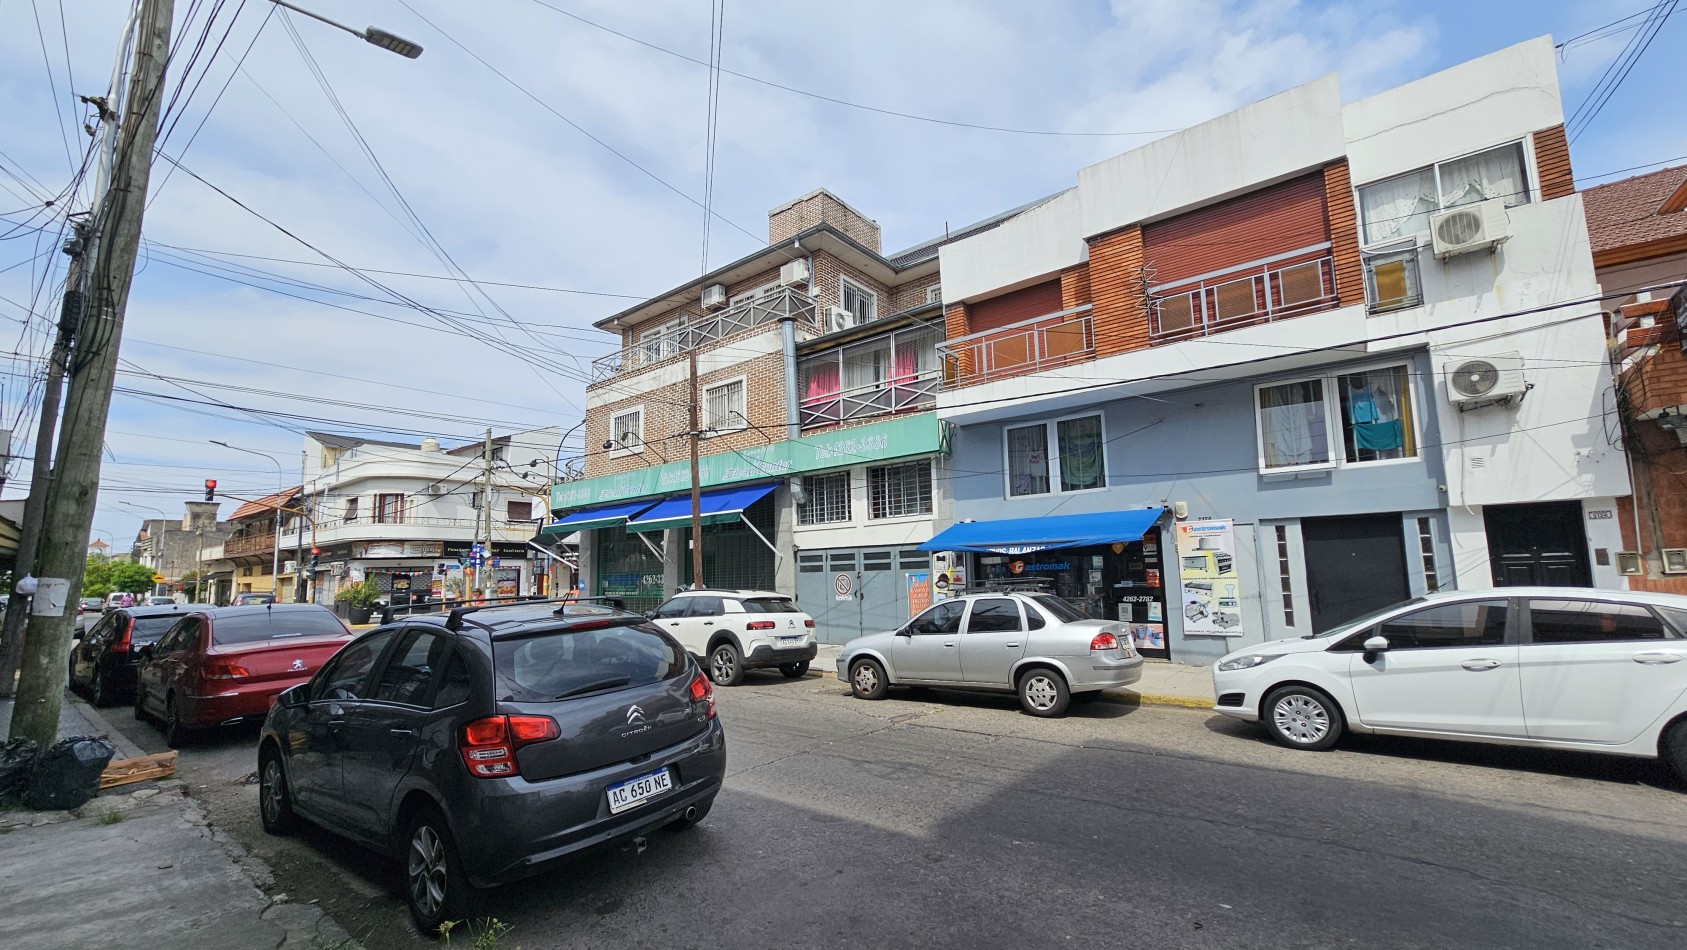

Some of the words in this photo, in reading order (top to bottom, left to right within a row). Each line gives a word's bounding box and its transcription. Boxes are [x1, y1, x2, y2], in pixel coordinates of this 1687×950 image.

[1015, 562, 1070, 573] Gastromak
[612, 789, 627, 806] AC
[631, 780, 651, 798] 650
[654, 774, 669, 791] NE
